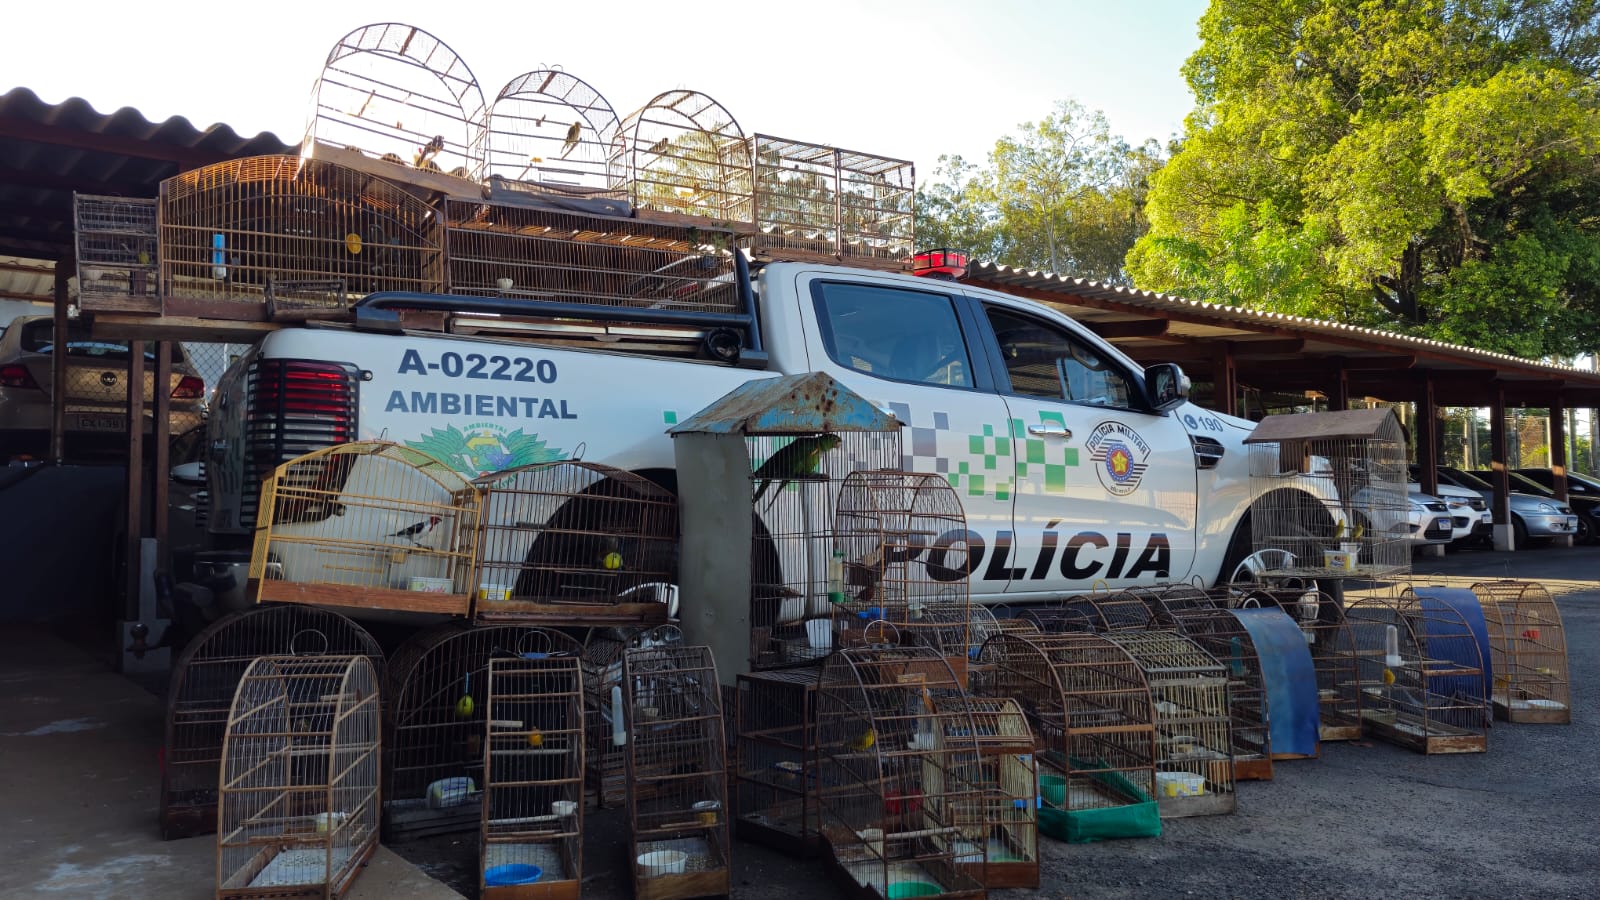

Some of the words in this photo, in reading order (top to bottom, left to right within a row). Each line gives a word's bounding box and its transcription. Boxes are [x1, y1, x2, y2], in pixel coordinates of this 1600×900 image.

[397, 348, 558, 384] A-02220
[384, 390, 578, 420] AMBIENTAL
[1199, 416, 1224, 432] 190
[1117, 425, 1147, 455] MILITAR
[868, 518, 1171, 582] POLÍCIA
